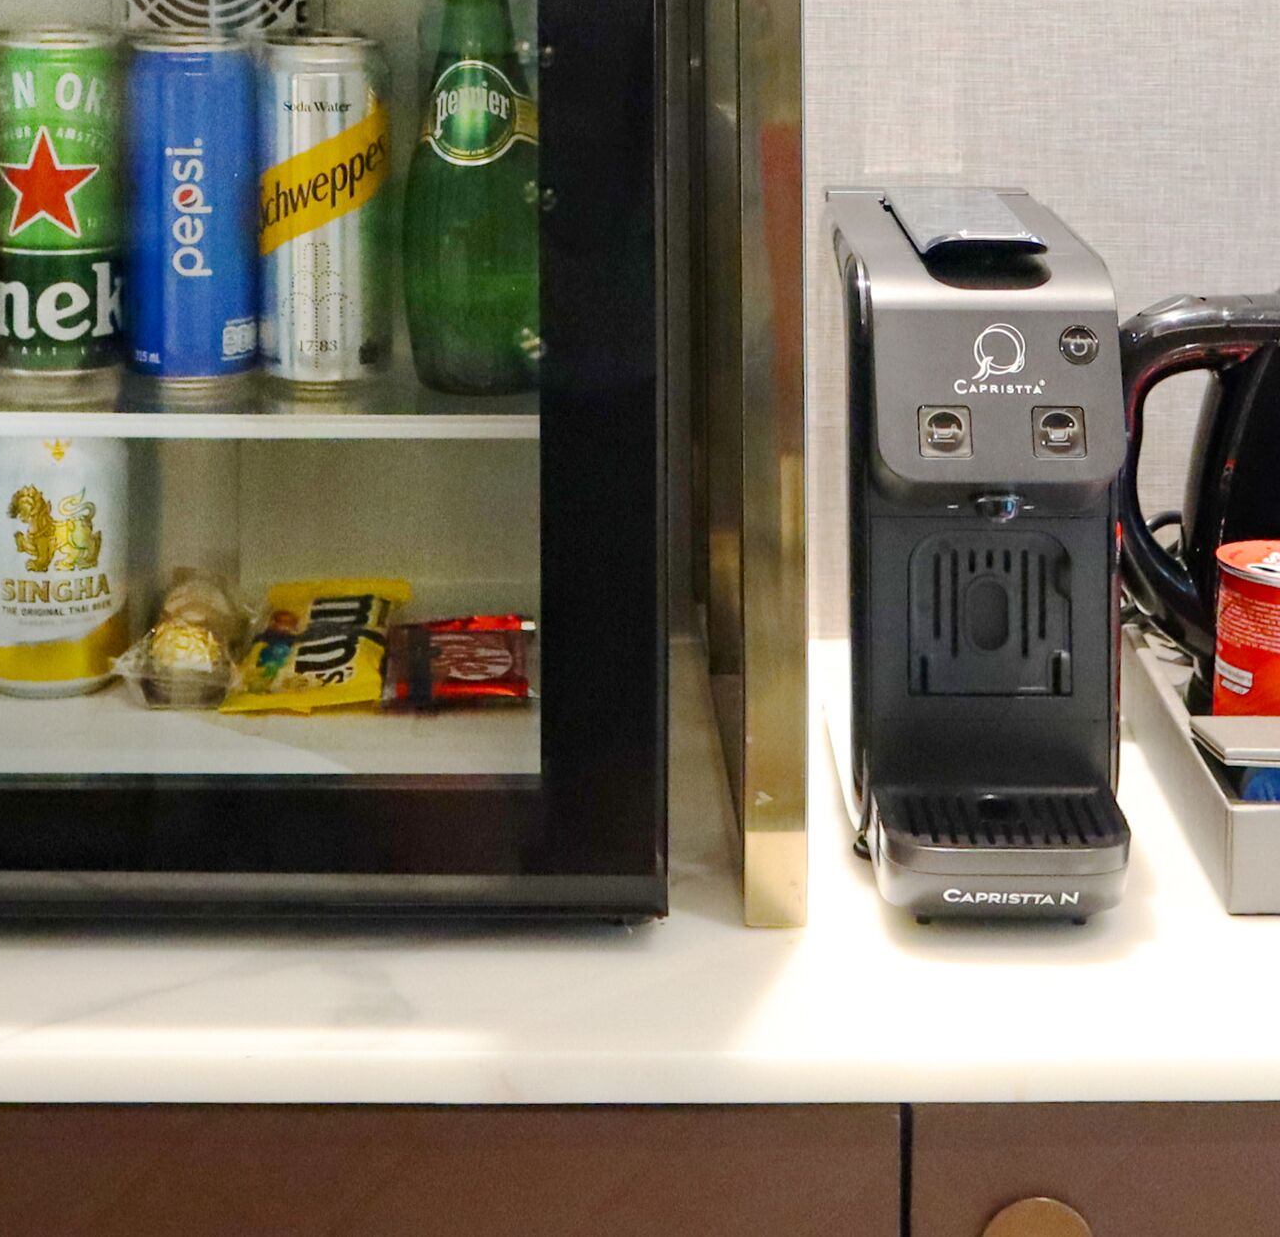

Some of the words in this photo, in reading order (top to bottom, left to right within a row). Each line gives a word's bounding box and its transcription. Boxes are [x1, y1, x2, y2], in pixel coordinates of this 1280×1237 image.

[284, 101, 312, 113] Soda
[313, 101, 352, 113] Water
[299, 339, 338, 353] 1783
[1, 573, 111, 603] SINGHA
[943, 888, 1055, 906] CAPRISTTA
[1059, 891, 1080, 906] N
